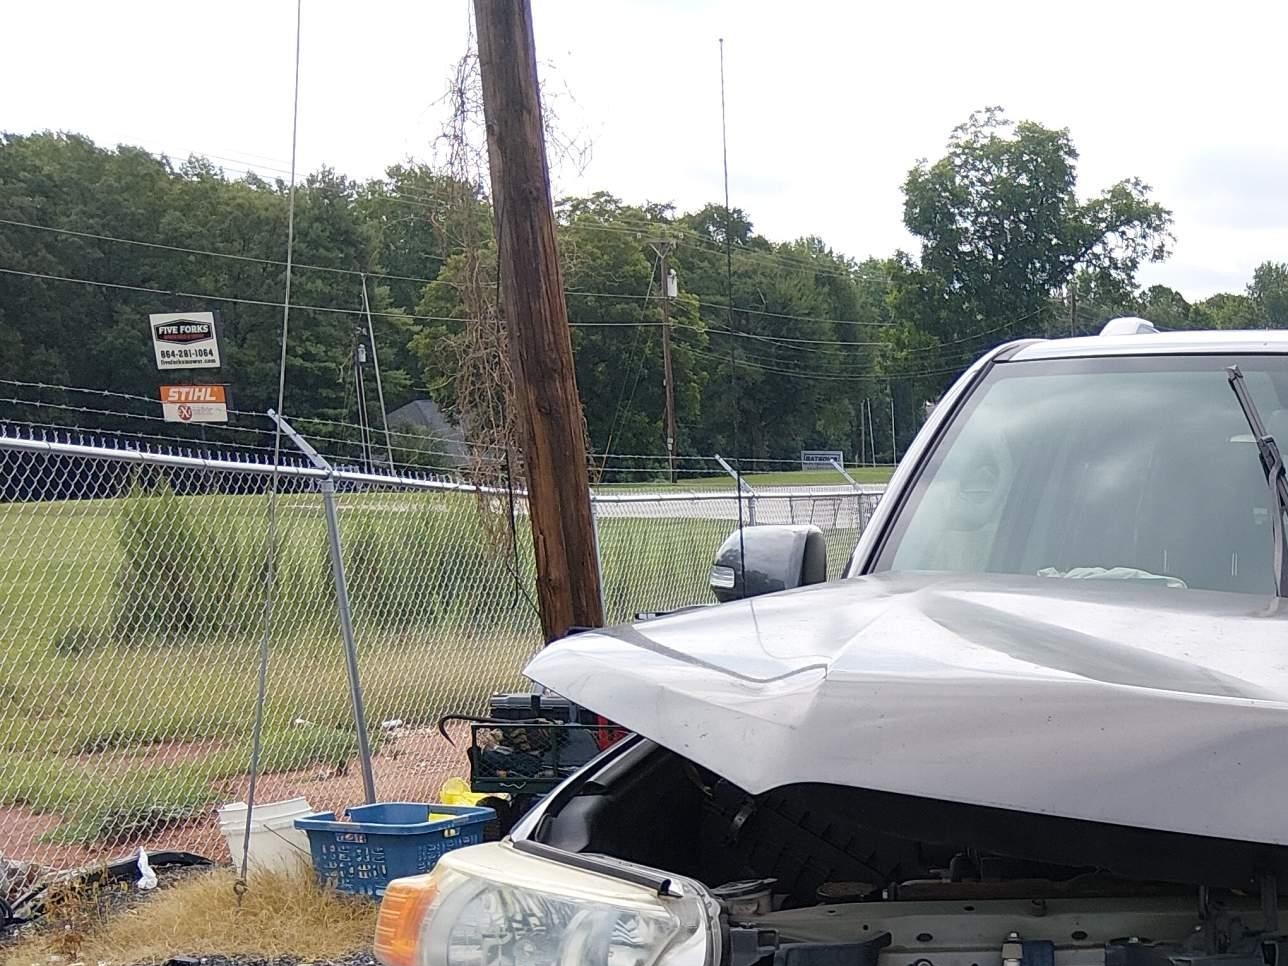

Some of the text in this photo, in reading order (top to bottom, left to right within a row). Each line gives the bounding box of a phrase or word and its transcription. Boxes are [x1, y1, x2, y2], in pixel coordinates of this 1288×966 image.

[159, 325, 209, 334] FIVE FORKS
[161, 349, 214, 359] 864-281-1064
[168, 387, 217, 400] STIHL
